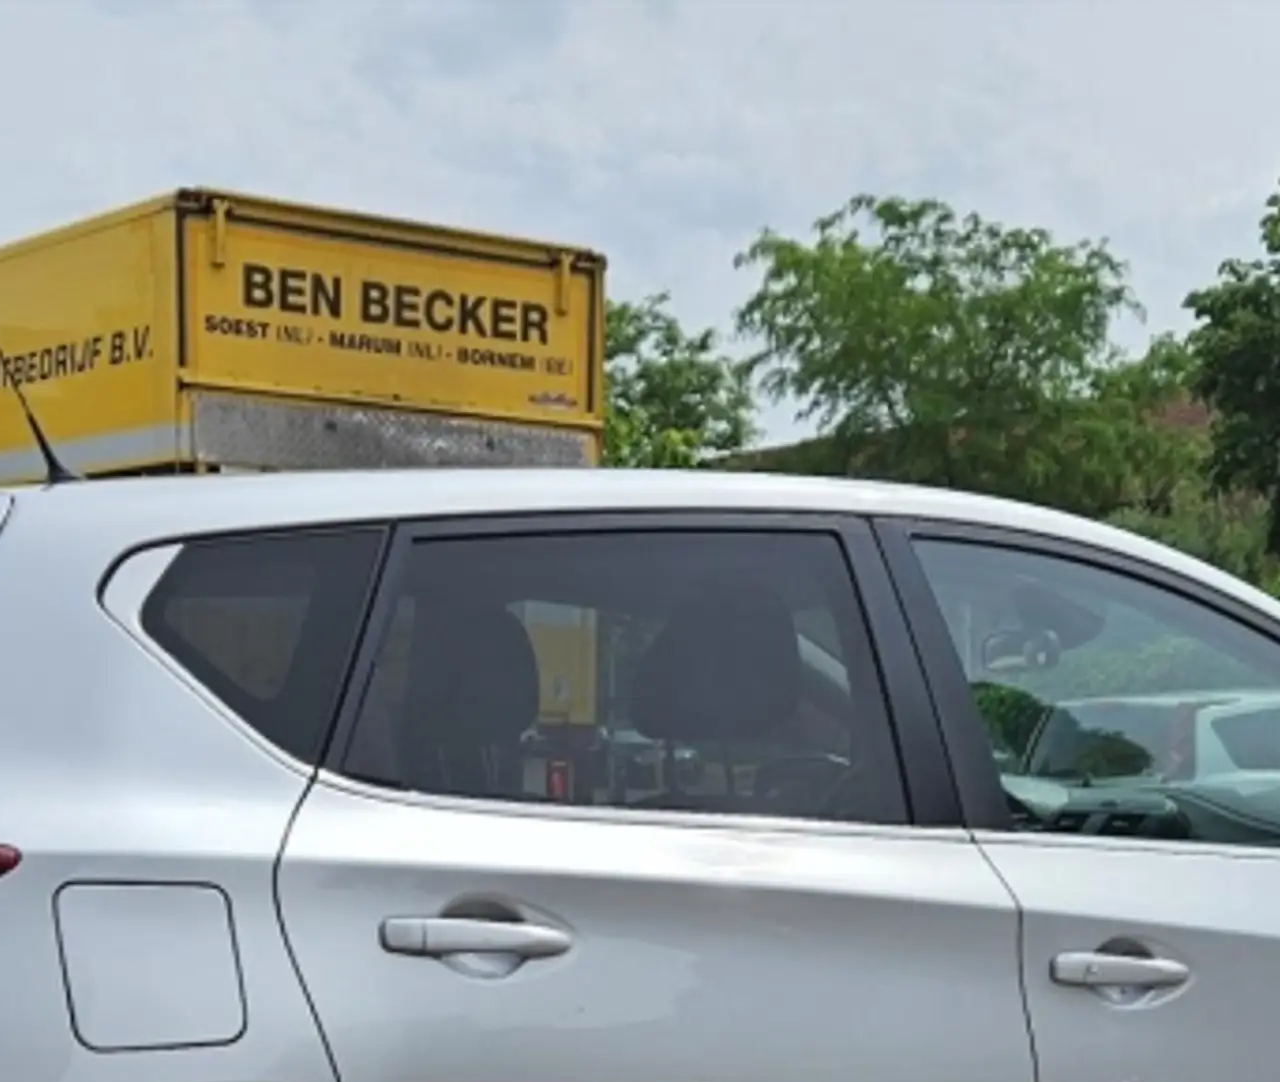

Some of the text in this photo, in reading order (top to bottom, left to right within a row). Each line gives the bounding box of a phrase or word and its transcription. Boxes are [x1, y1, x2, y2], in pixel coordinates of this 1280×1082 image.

[242, 262, 548, 345] BEN BECKER
[108, 326, 154, 364] B.V.
[204, 315, 269, 338] SOEST
[329, 331, 401, 356] MARUM
[457, 347, 536, 370] BORNEM
